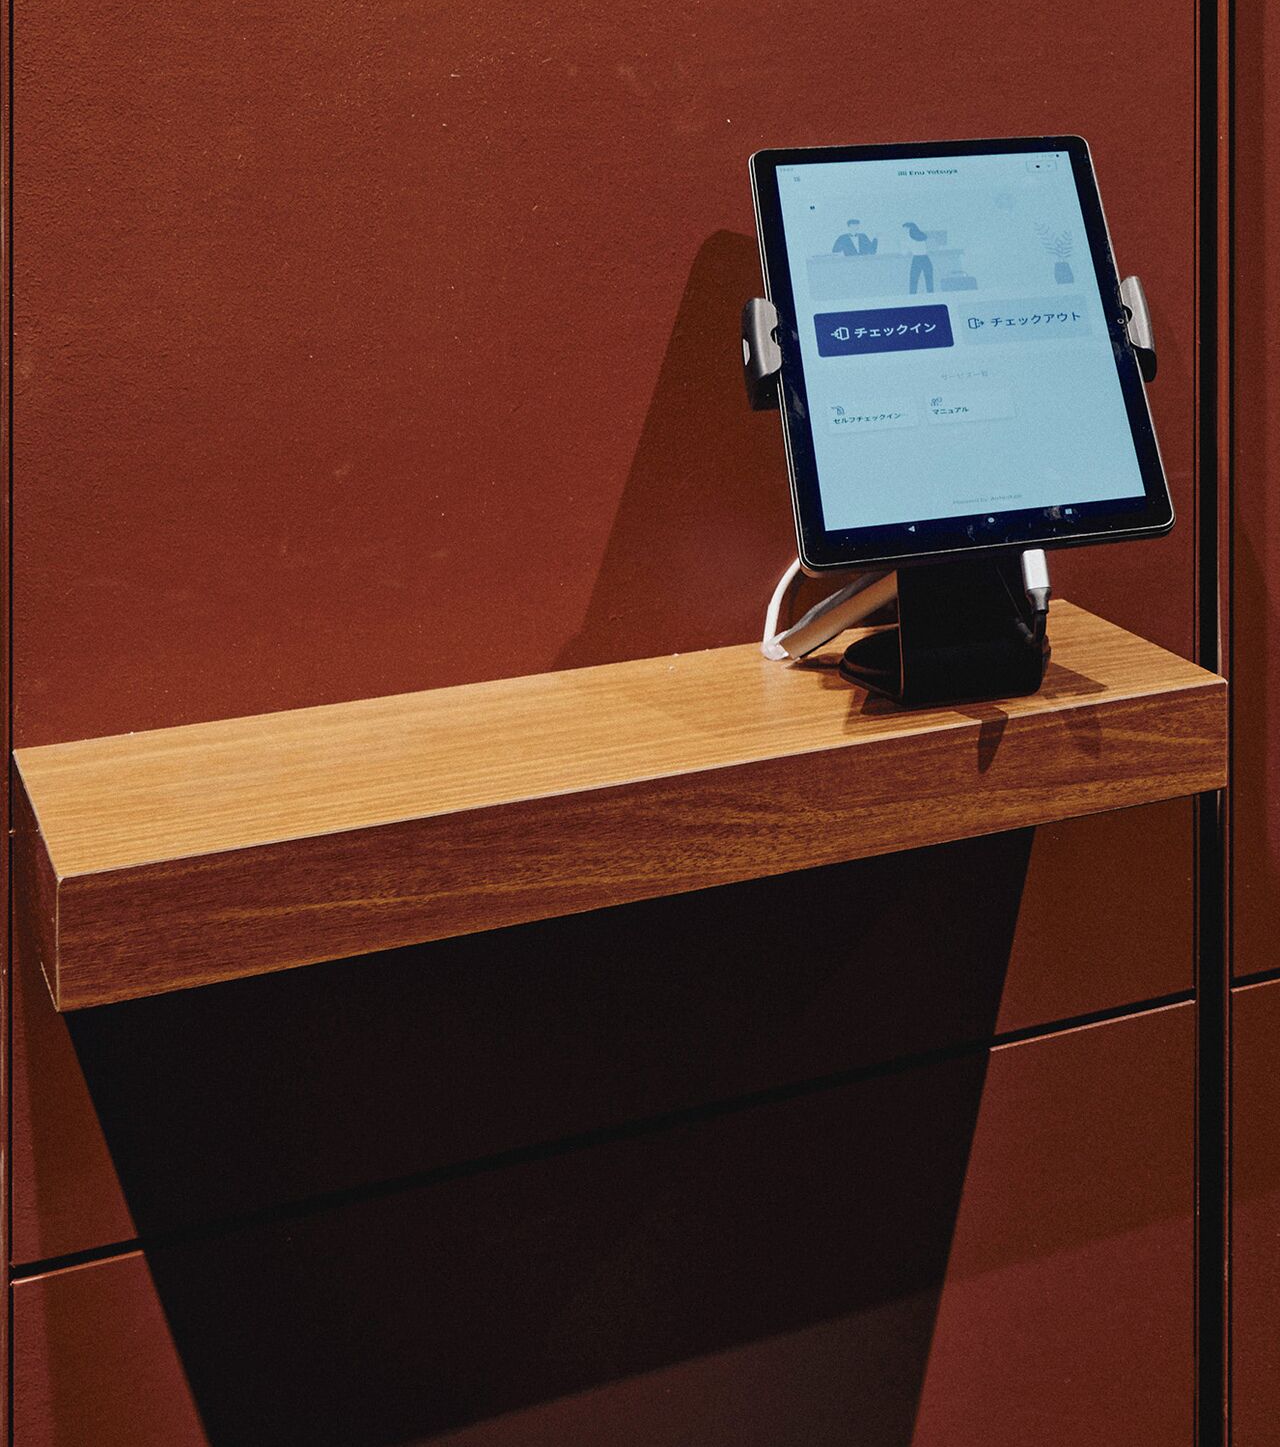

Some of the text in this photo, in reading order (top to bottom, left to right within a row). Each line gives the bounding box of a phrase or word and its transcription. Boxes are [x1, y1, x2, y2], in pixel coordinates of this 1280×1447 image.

[991, 311, 1081, 328] チェックアウト
[853, 322, 937, 339] チェックイン
[833, 412, 902, 425] セルフチェックイン
[932, 406, 969, 416] マニュアル
